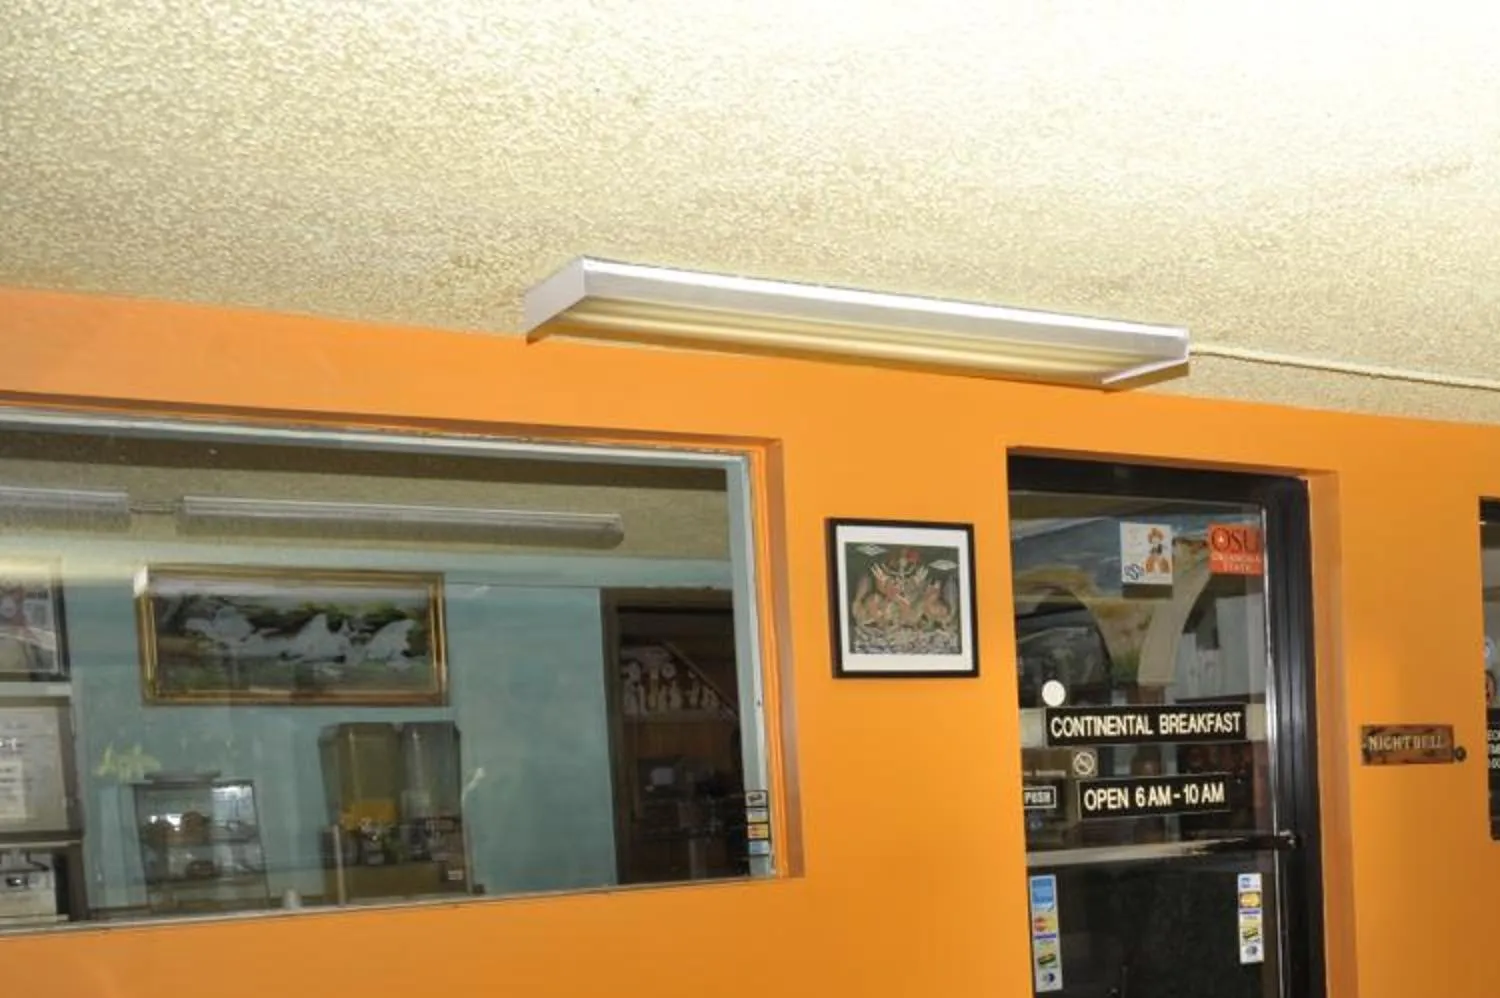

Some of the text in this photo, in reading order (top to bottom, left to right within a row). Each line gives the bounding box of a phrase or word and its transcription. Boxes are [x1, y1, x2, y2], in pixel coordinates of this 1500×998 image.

[1211, 527, 1260, 553] OSU
[1050, 711, 1242, 738] CONTINENTAL BREAKFAST
[1083, 787, 1129, 811] OPEN
